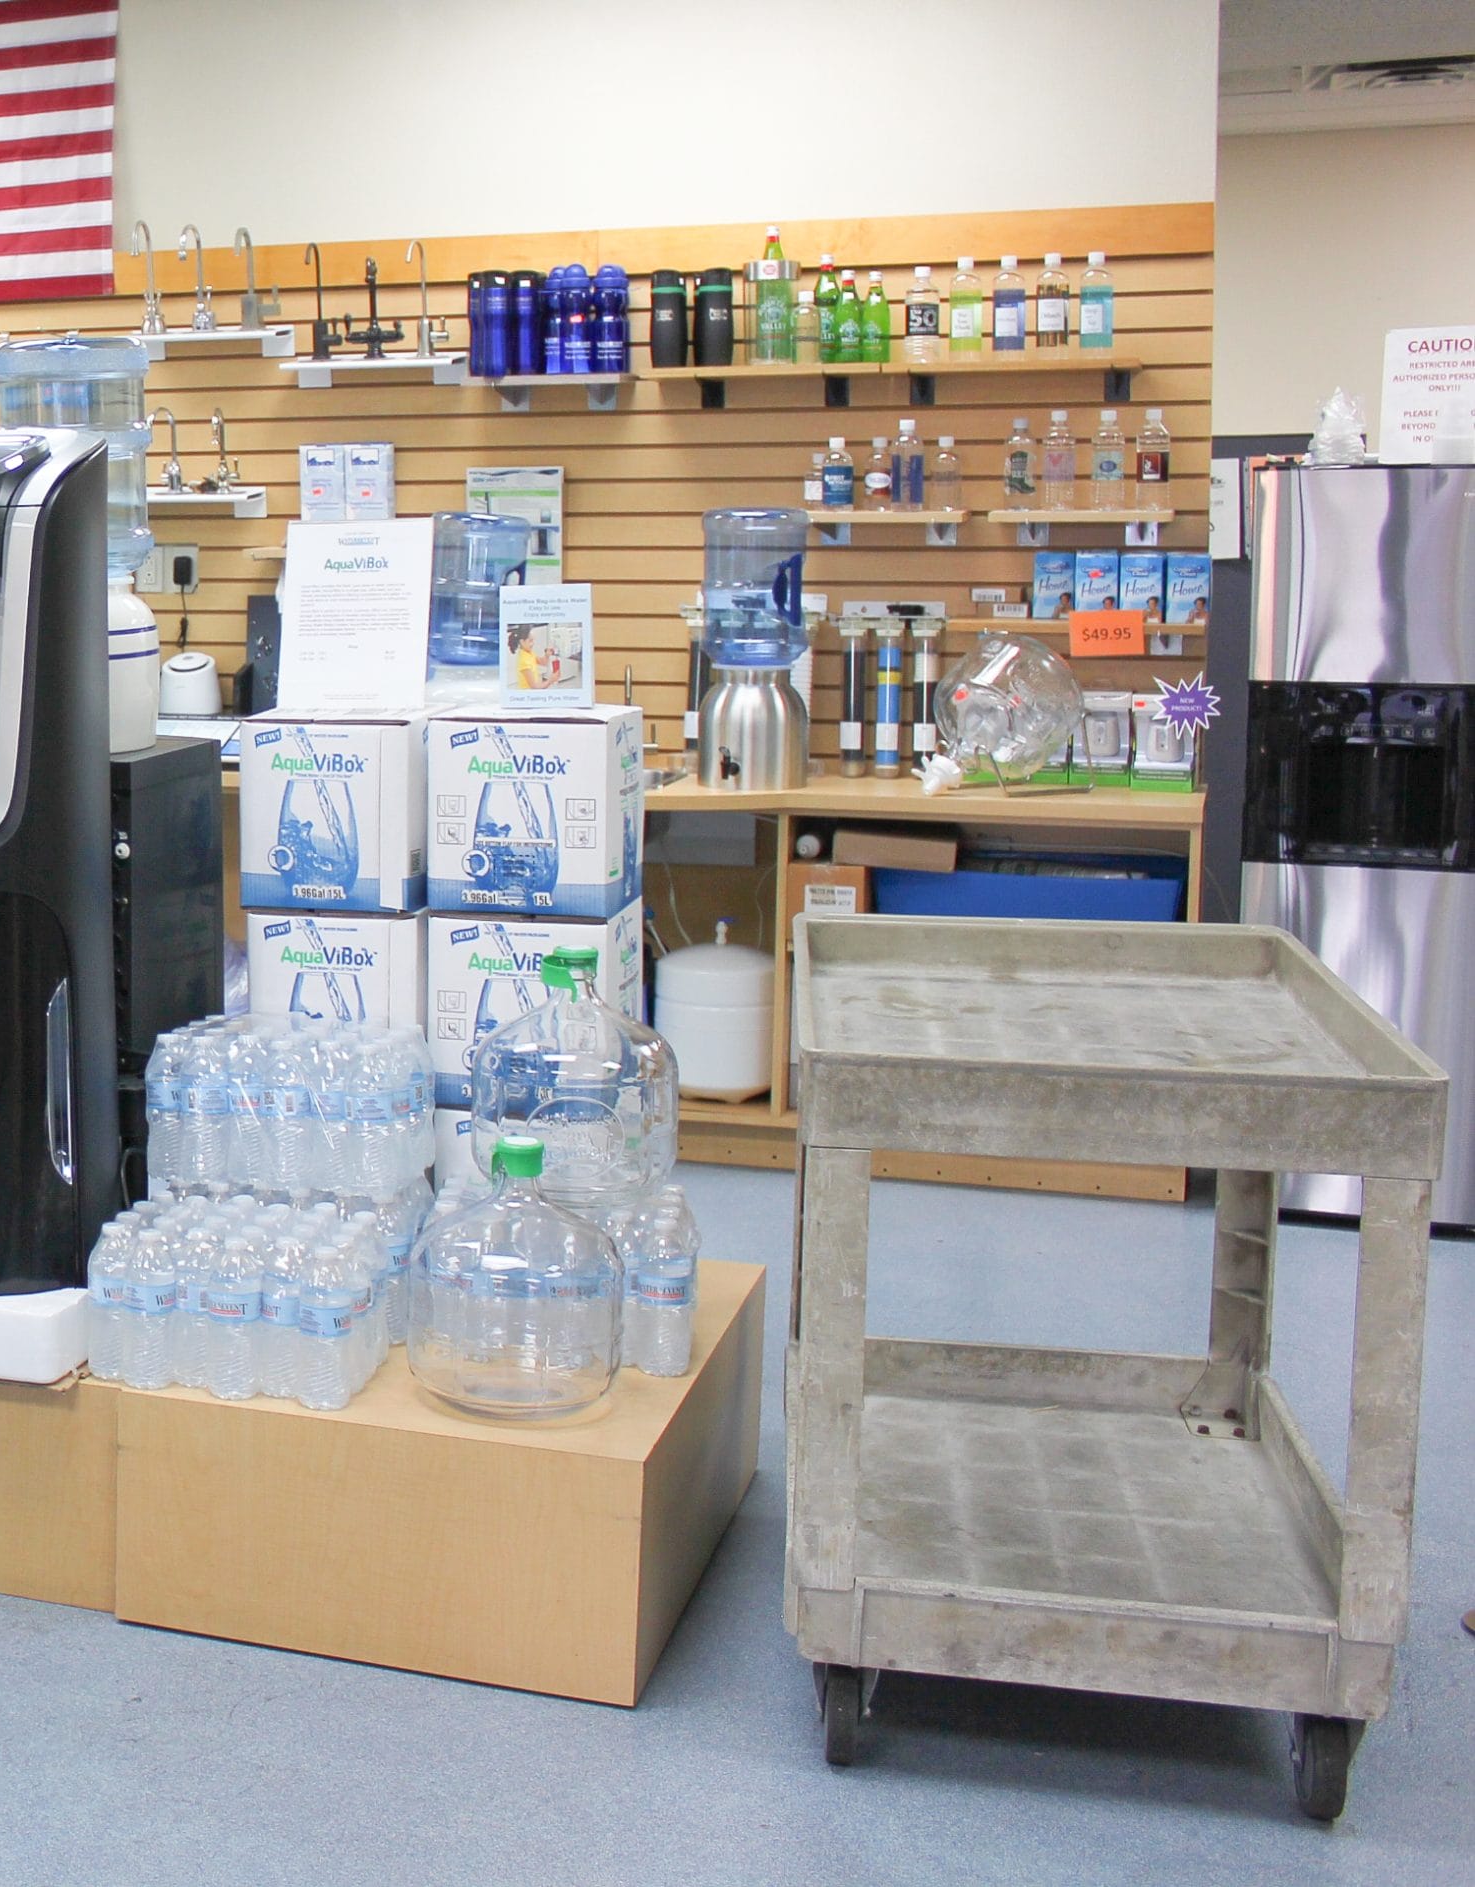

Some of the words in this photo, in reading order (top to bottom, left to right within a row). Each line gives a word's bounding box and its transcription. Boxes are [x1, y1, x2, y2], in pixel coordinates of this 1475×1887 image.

[909, 309, 937, 328] 50
[1407, 338, 1475, 354] CAUTIO
[1409, 361, 1458, 369] RESTRICTED
[1392, 373, 1446, 382] AUTHORIZED
[1428, 384, 1461, 392] ONLY!!!
[1403, 409, 1433, 418] PLEASE
[1401, 422, 1436, 431] BEYOND
[1412, 435, 1422, 443] IN
[324, 556, 389, 573] AquaViBox
[1038, 578, 1069, 594] Home
[1081, 580, 1112, 597] Home
[1125, 579, 1155, 597] Home
[1172, 579, 1205, 597] Home
[1082, 627, 1131, 642] $49.95
[256, 729, 282, 746] NEW!
[452, 731, 478, 746] NEW!
[271, 752, 365, 776] AquaViBox
[468, 754, 566, 778] AquaViBox
[328, 888, 344, 899] 15L
[461, 892, 496, 904] 3.96Gal
[533, 894, 550, 906] 15L
[265, 924, 290, 937] NEW!
[452, 928, 478, 943] NEW!
[280, 945, 374, 968] AquaViBox
[468, 951, 543, 975] AquaViB
